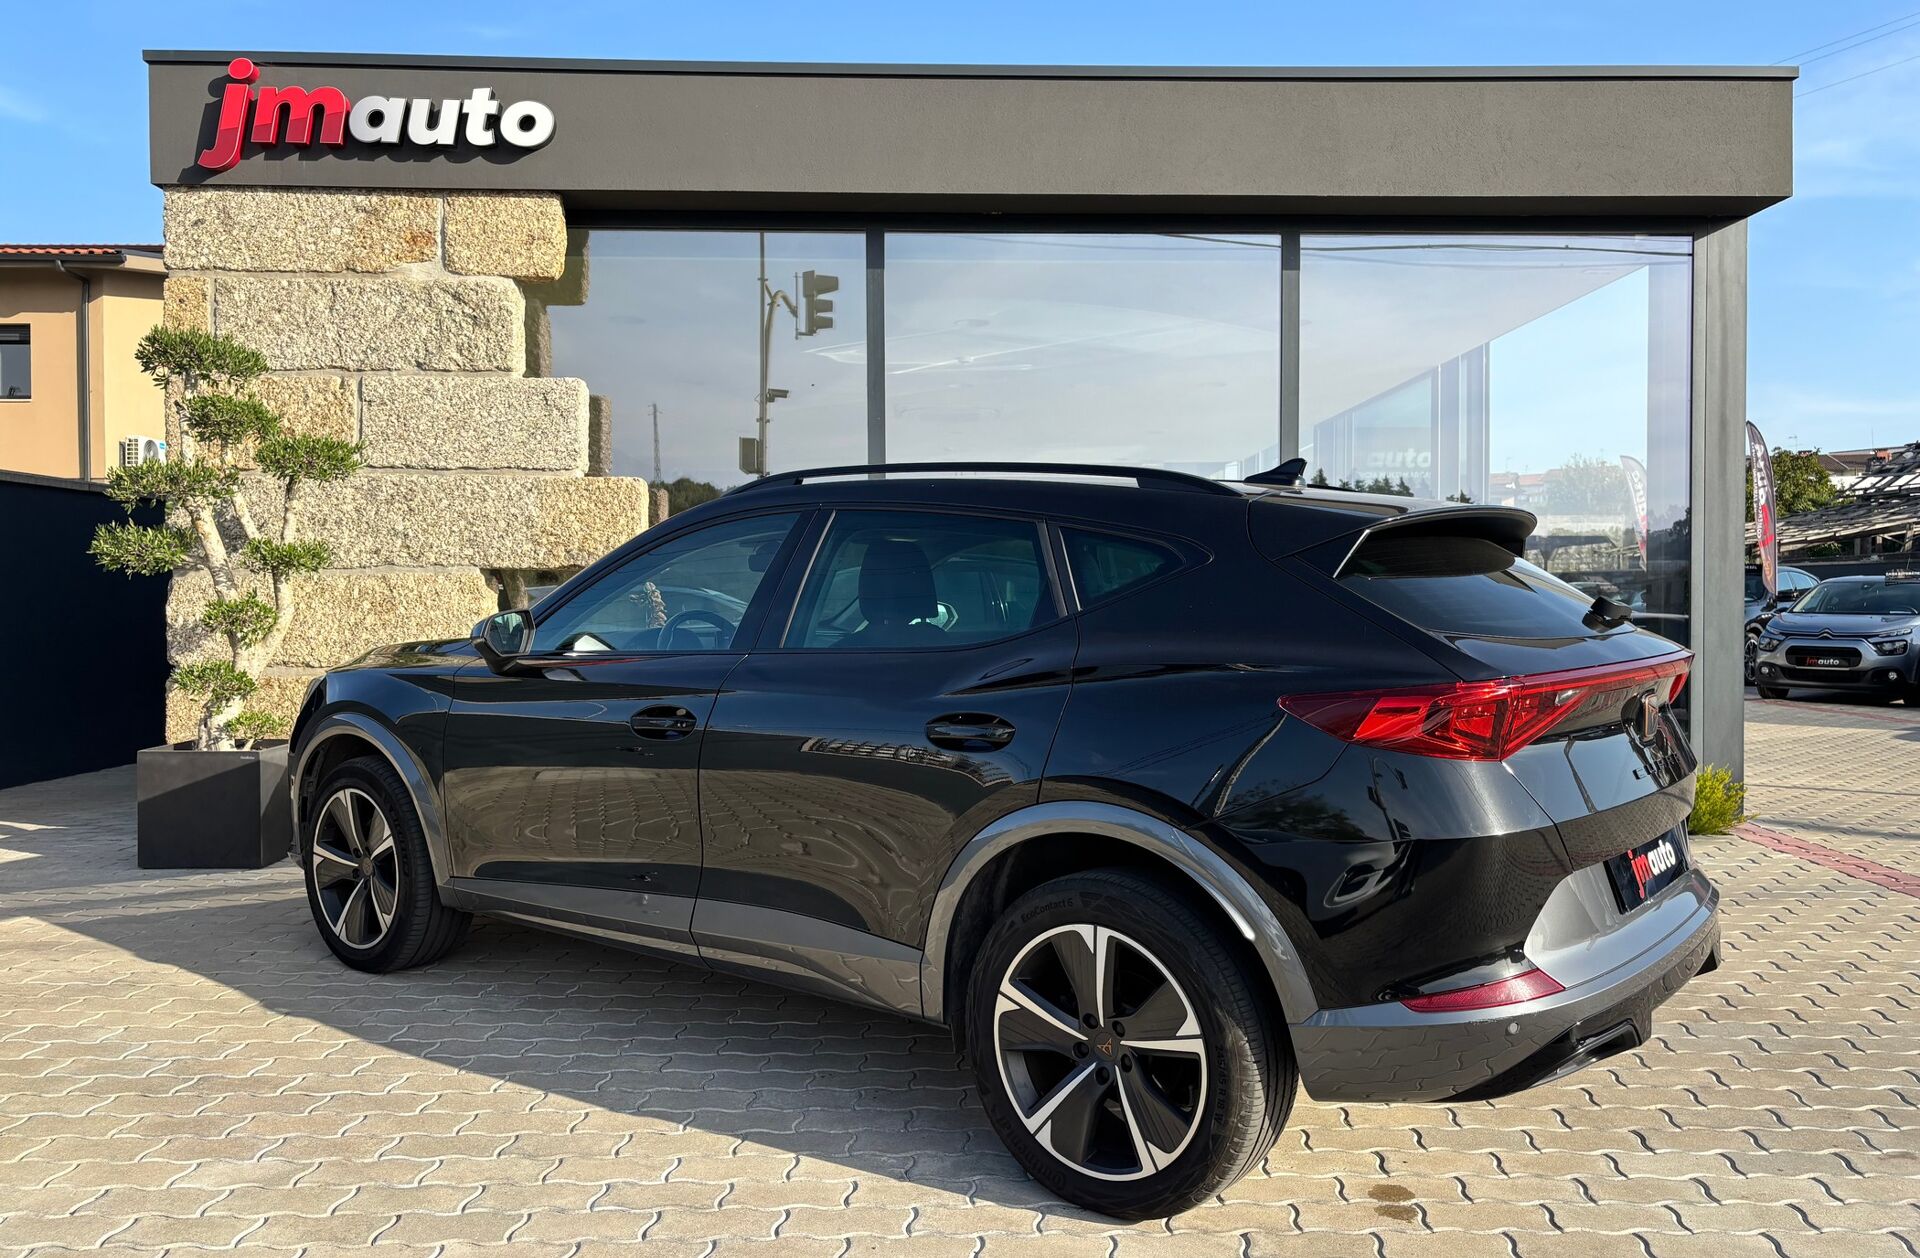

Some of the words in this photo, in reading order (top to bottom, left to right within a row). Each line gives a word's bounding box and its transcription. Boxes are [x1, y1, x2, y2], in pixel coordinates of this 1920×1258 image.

[198, 57, 556, 170] jmauto
[1627, 839, 1676, 899] jmauto
[1021, 898, 1066, 923] EcoContact
